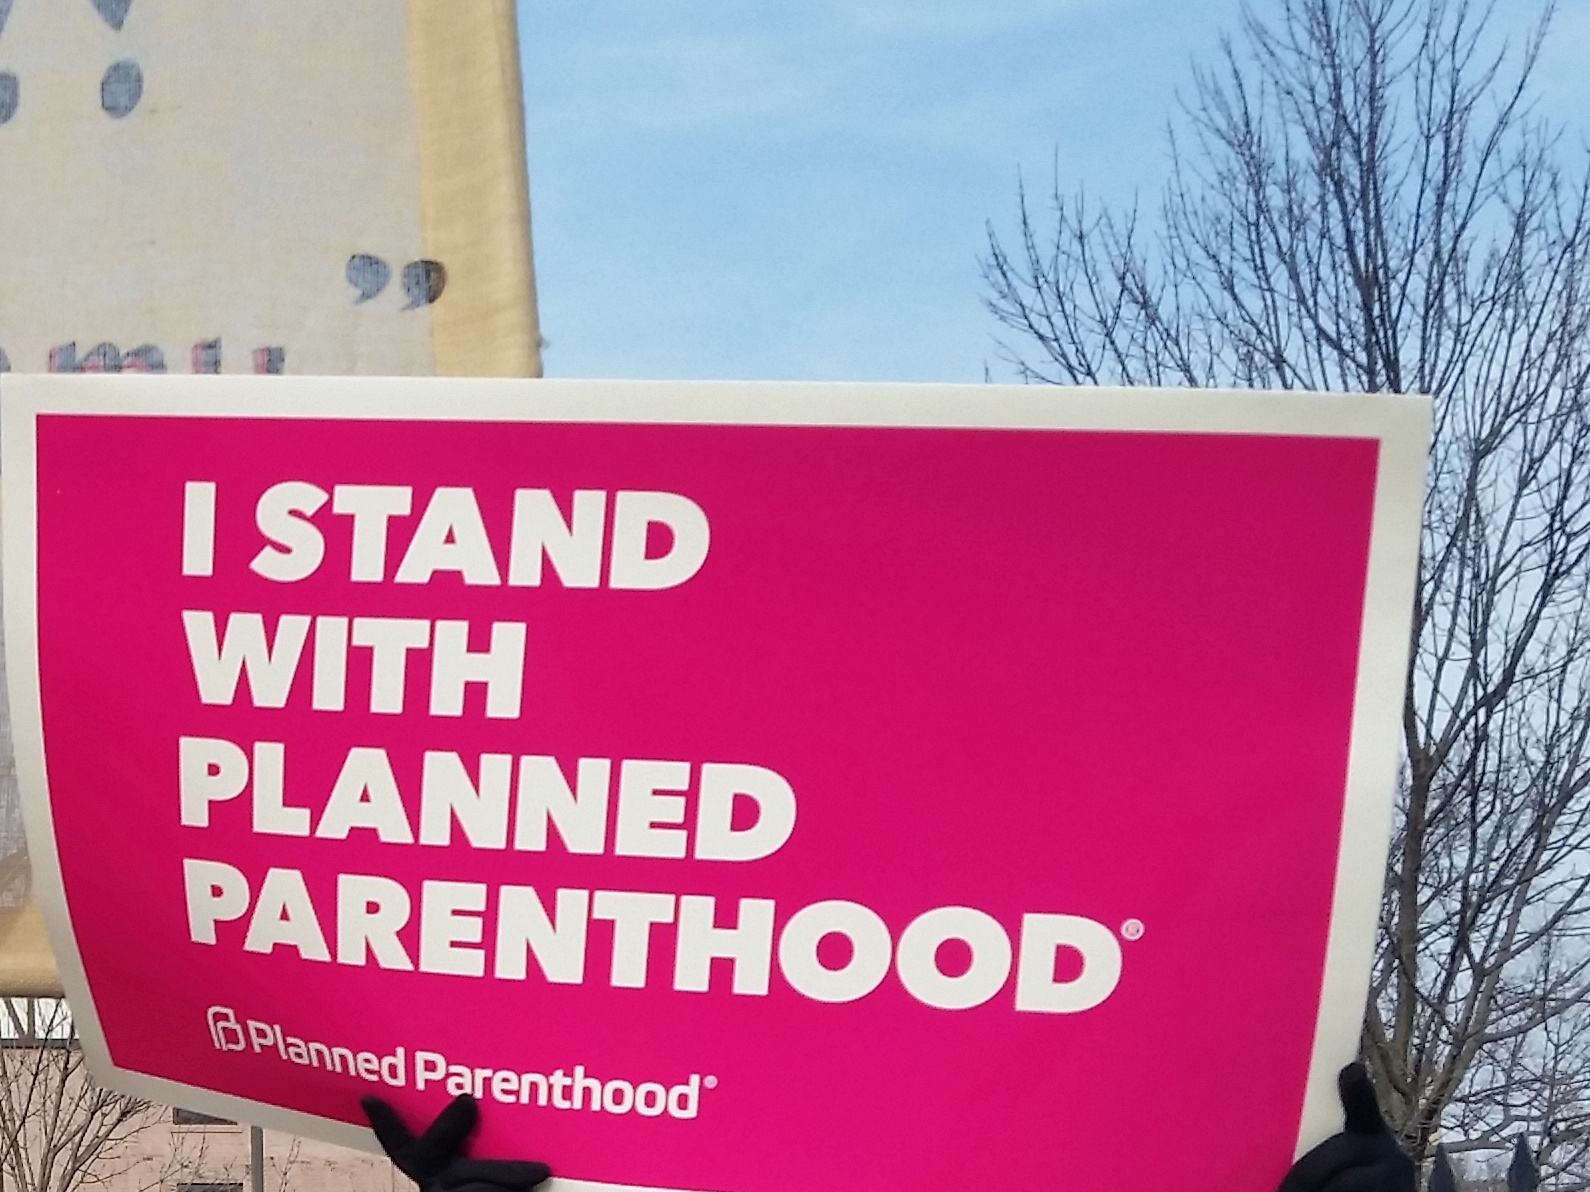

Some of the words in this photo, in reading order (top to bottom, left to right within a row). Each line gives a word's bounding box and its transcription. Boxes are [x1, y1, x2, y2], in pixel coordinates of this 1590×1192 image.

[182, 481, 216, 577] I
[249, 481, 710, 590] STAND
[183, 610, 527, 719] WITH
[178, 736, 797, 862] PLANNED
[246, 1020, 406, 1087] Planned
